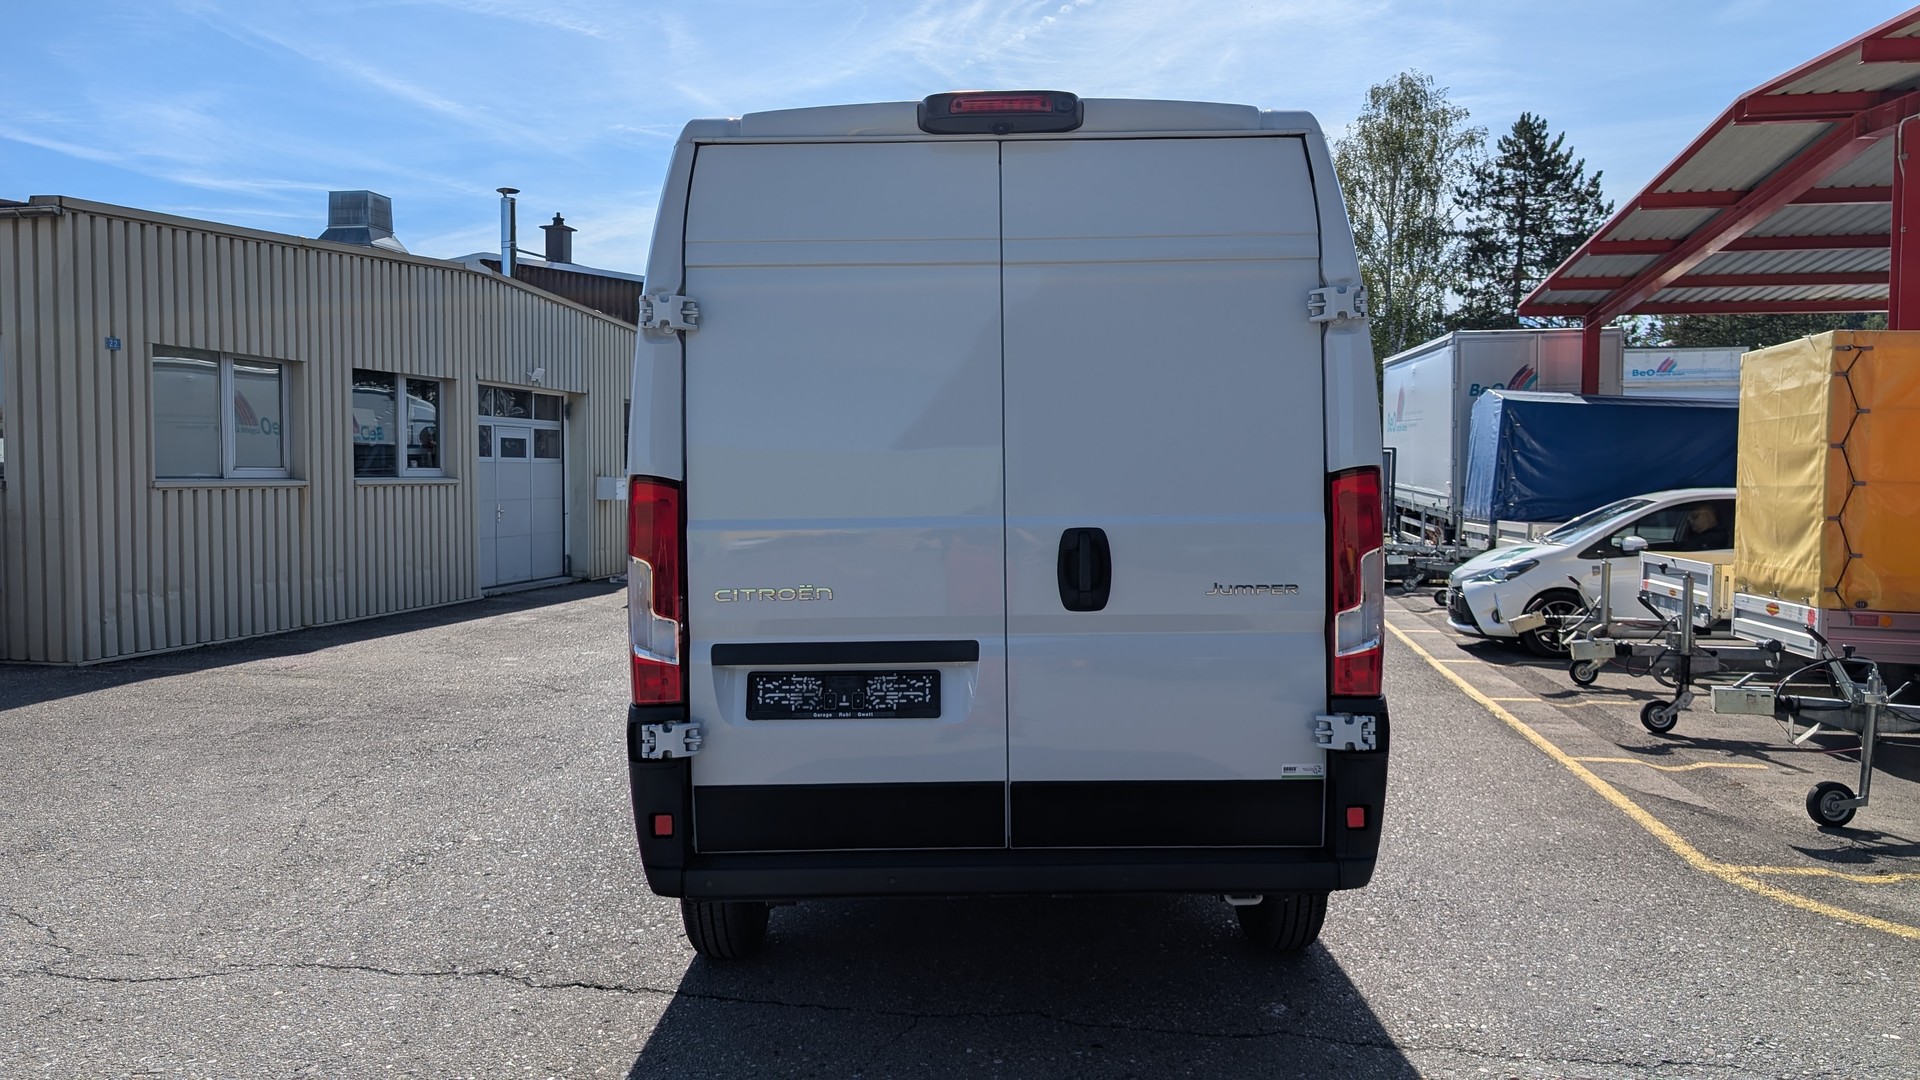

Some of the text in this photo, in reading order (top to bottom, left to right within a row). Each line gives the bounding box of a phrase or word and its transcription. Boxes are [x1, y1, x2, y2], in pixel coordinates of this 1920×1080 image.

[109, 339, 118, 348] 22
[1631, 368, 1656, 377] BeO
[714, 584, 834, 602] CITROËN
[1205, 582, 1299, 595] JUMPER
